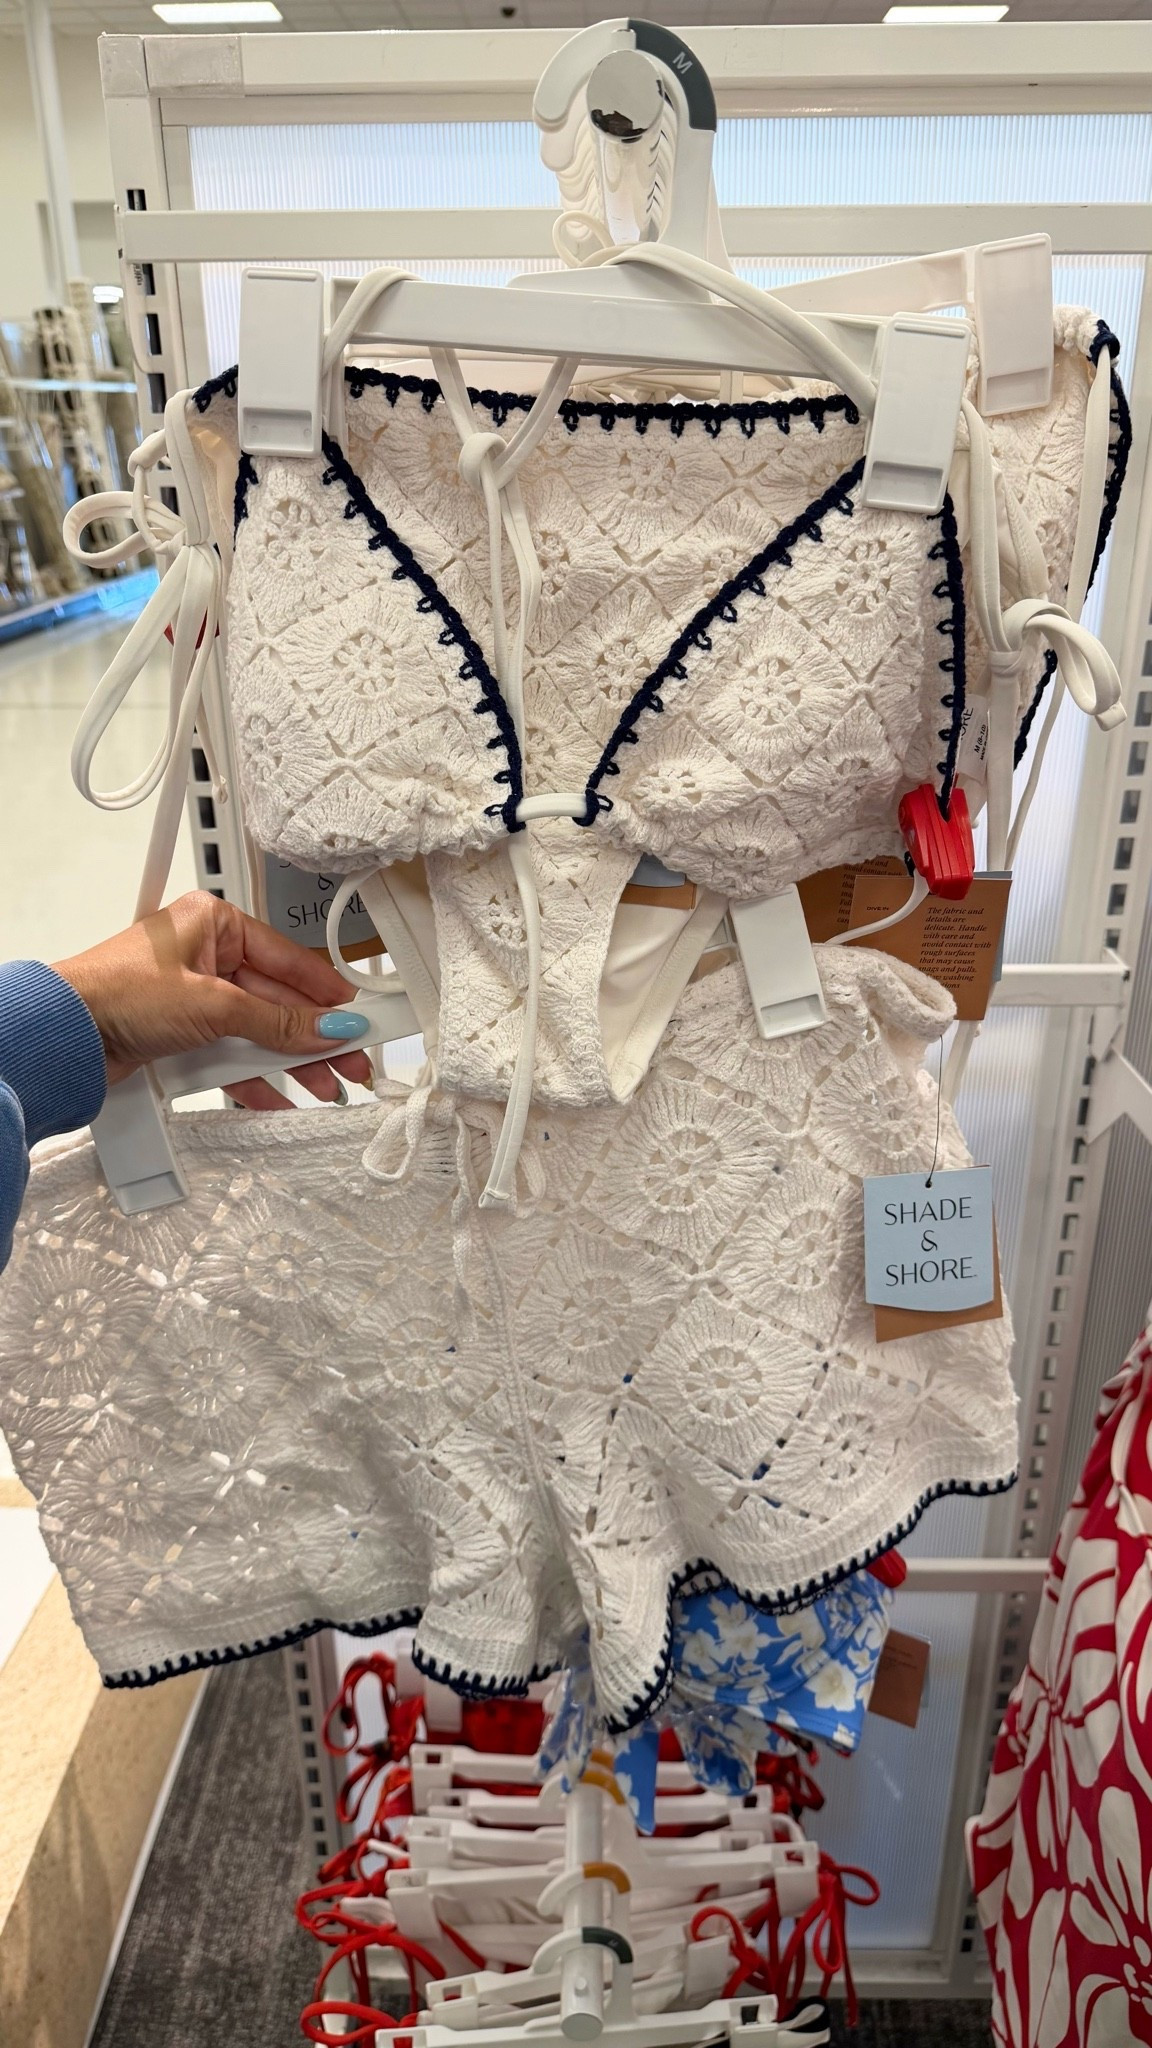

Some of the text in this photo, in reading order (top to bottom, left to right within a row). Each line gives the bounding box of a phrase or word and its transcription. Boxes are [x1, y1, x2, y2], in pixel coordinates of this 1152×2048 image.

[672, 51, 693, 74] M
[941, 907, 966, 915] fabric
[920, 949, 976, 957] rough surfaces
[956, 966, 977, 974] pulls.
[943, 974, 975, 982] washing
[884, 1196, 973, 1226] SHADE
[920, 1229, 938, 1252] &
[885, 1256, 974, 1287] SHORE
